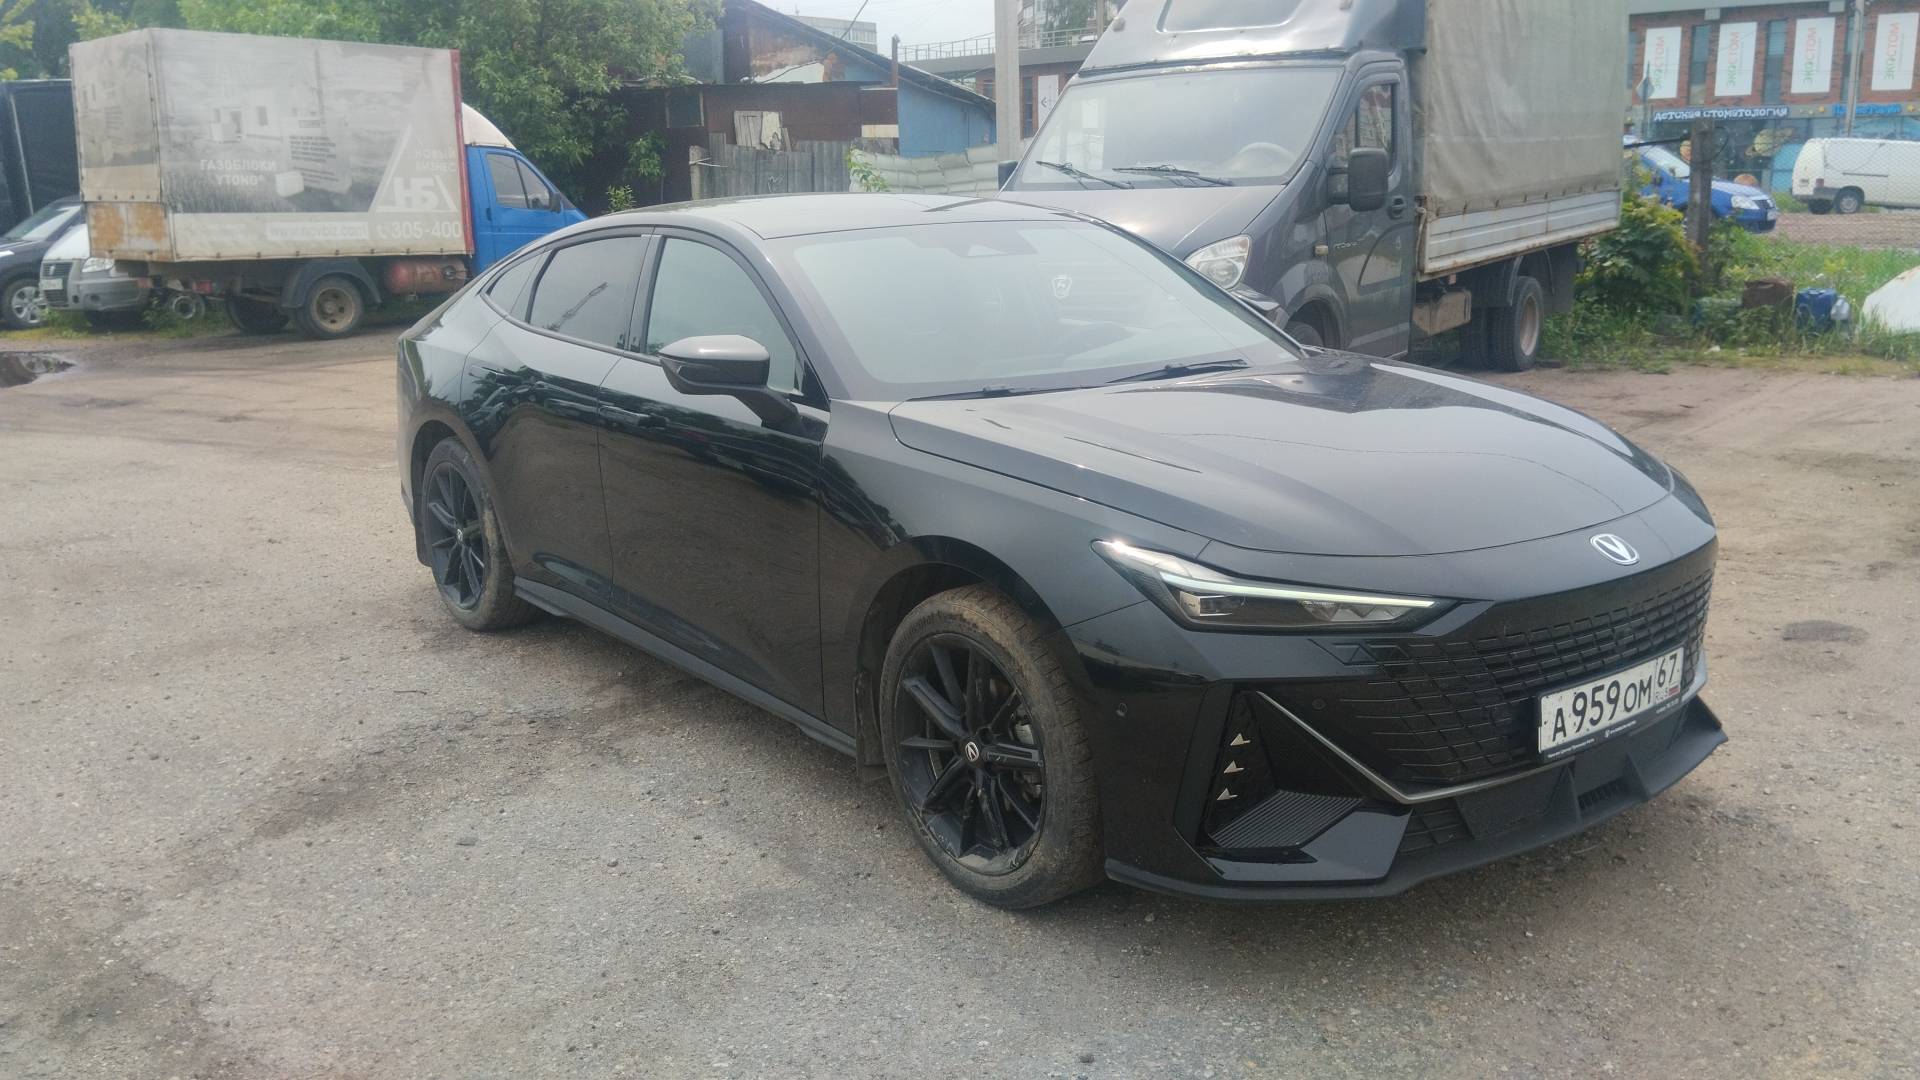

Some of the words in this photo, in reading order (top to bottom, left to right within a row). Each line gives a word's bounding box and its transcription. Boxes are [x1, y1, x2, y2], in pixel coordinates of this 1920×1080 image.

[200, 159, 277, 171] ГАЗОБЛОКИ
[391, 221, 462, 239] 305-400
[1657, 652, 1677, 688] 67
